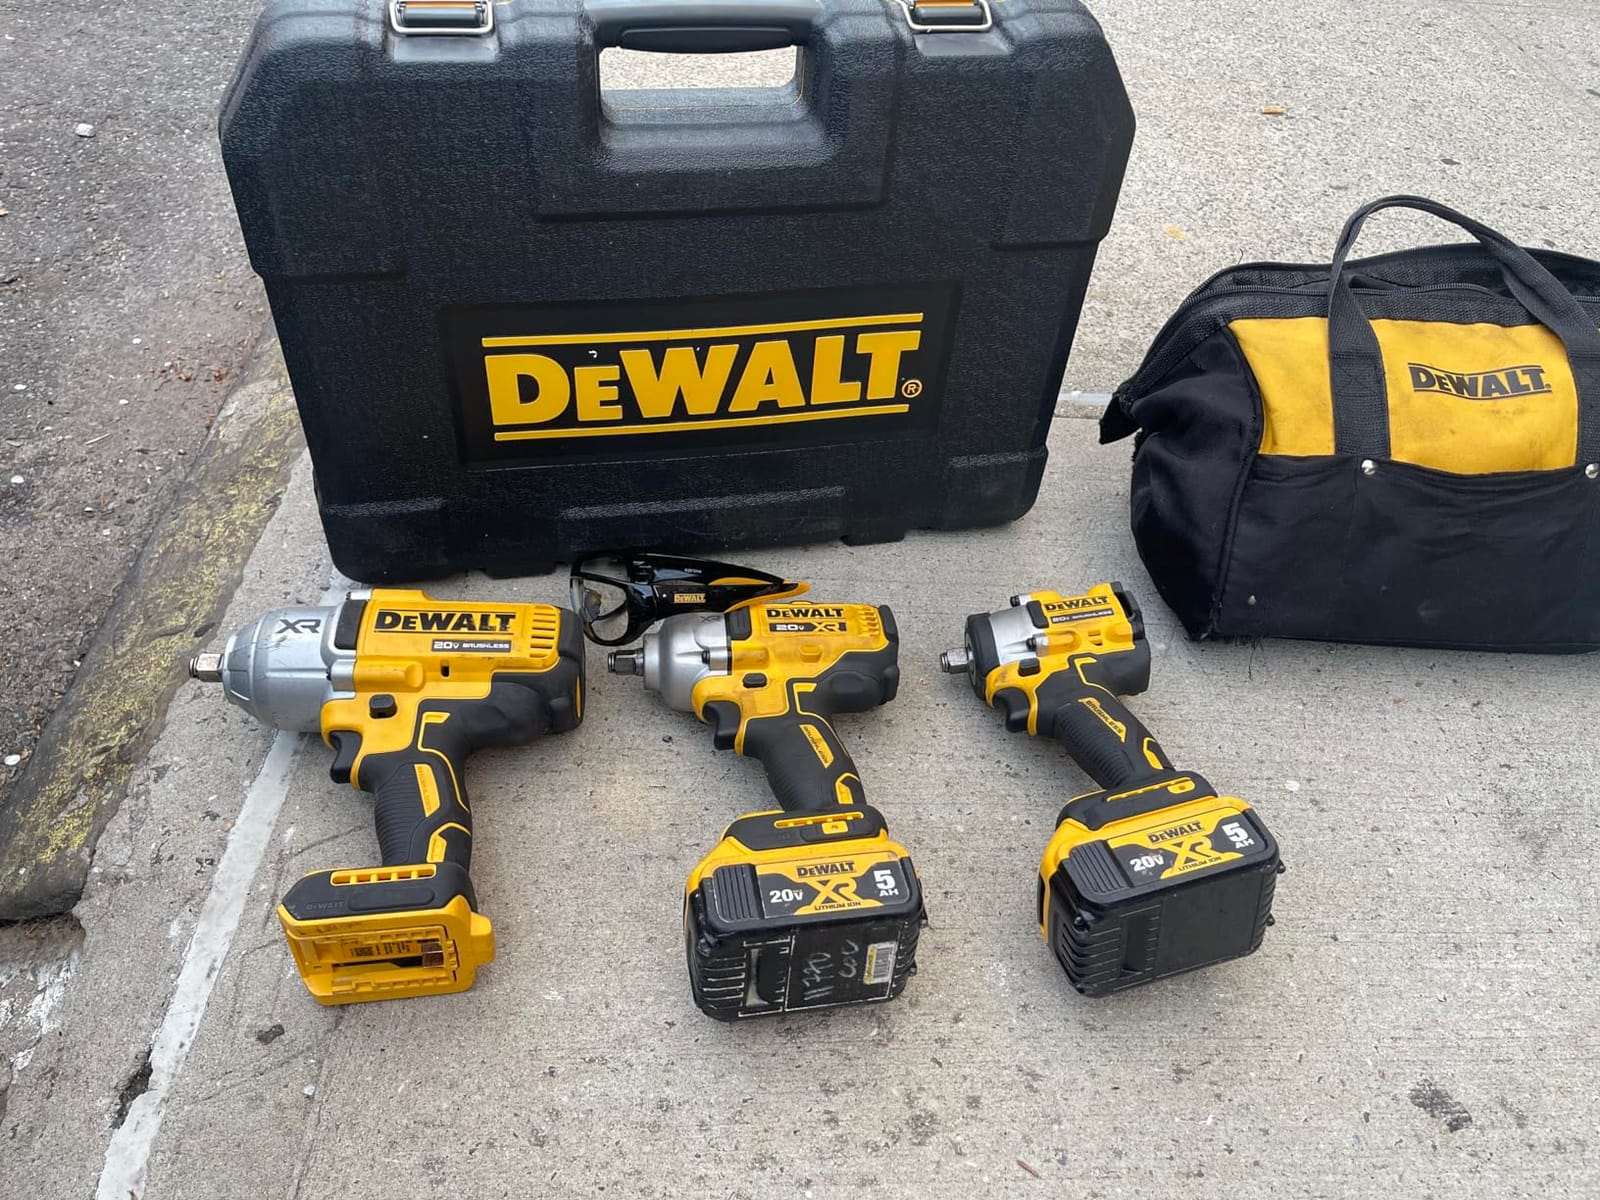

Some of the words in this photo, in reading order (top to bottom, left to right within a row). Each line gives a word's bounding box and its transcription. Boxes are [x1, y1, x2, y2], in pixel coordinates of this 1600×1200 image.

[484, 330, 922, 425] DEWALT
[1408, 366, 1546, 398] DEWALT
[766, 608, 844, 618] DEWALT
[1044, 596, 1108, 611] DEWALT
[275, 618, 322, 634] XR
[375, 611, 516, 633] DEWALT
[1148, 822, 1202, 843] DEWALT
[1221, 822, 1249, 842] 5
[1162, 836, 1217, 866] XR
[797, 861, 855, 877] DEWALT
[873, 869, 896, 890] 5
[806, 877, 862, 904] XR
